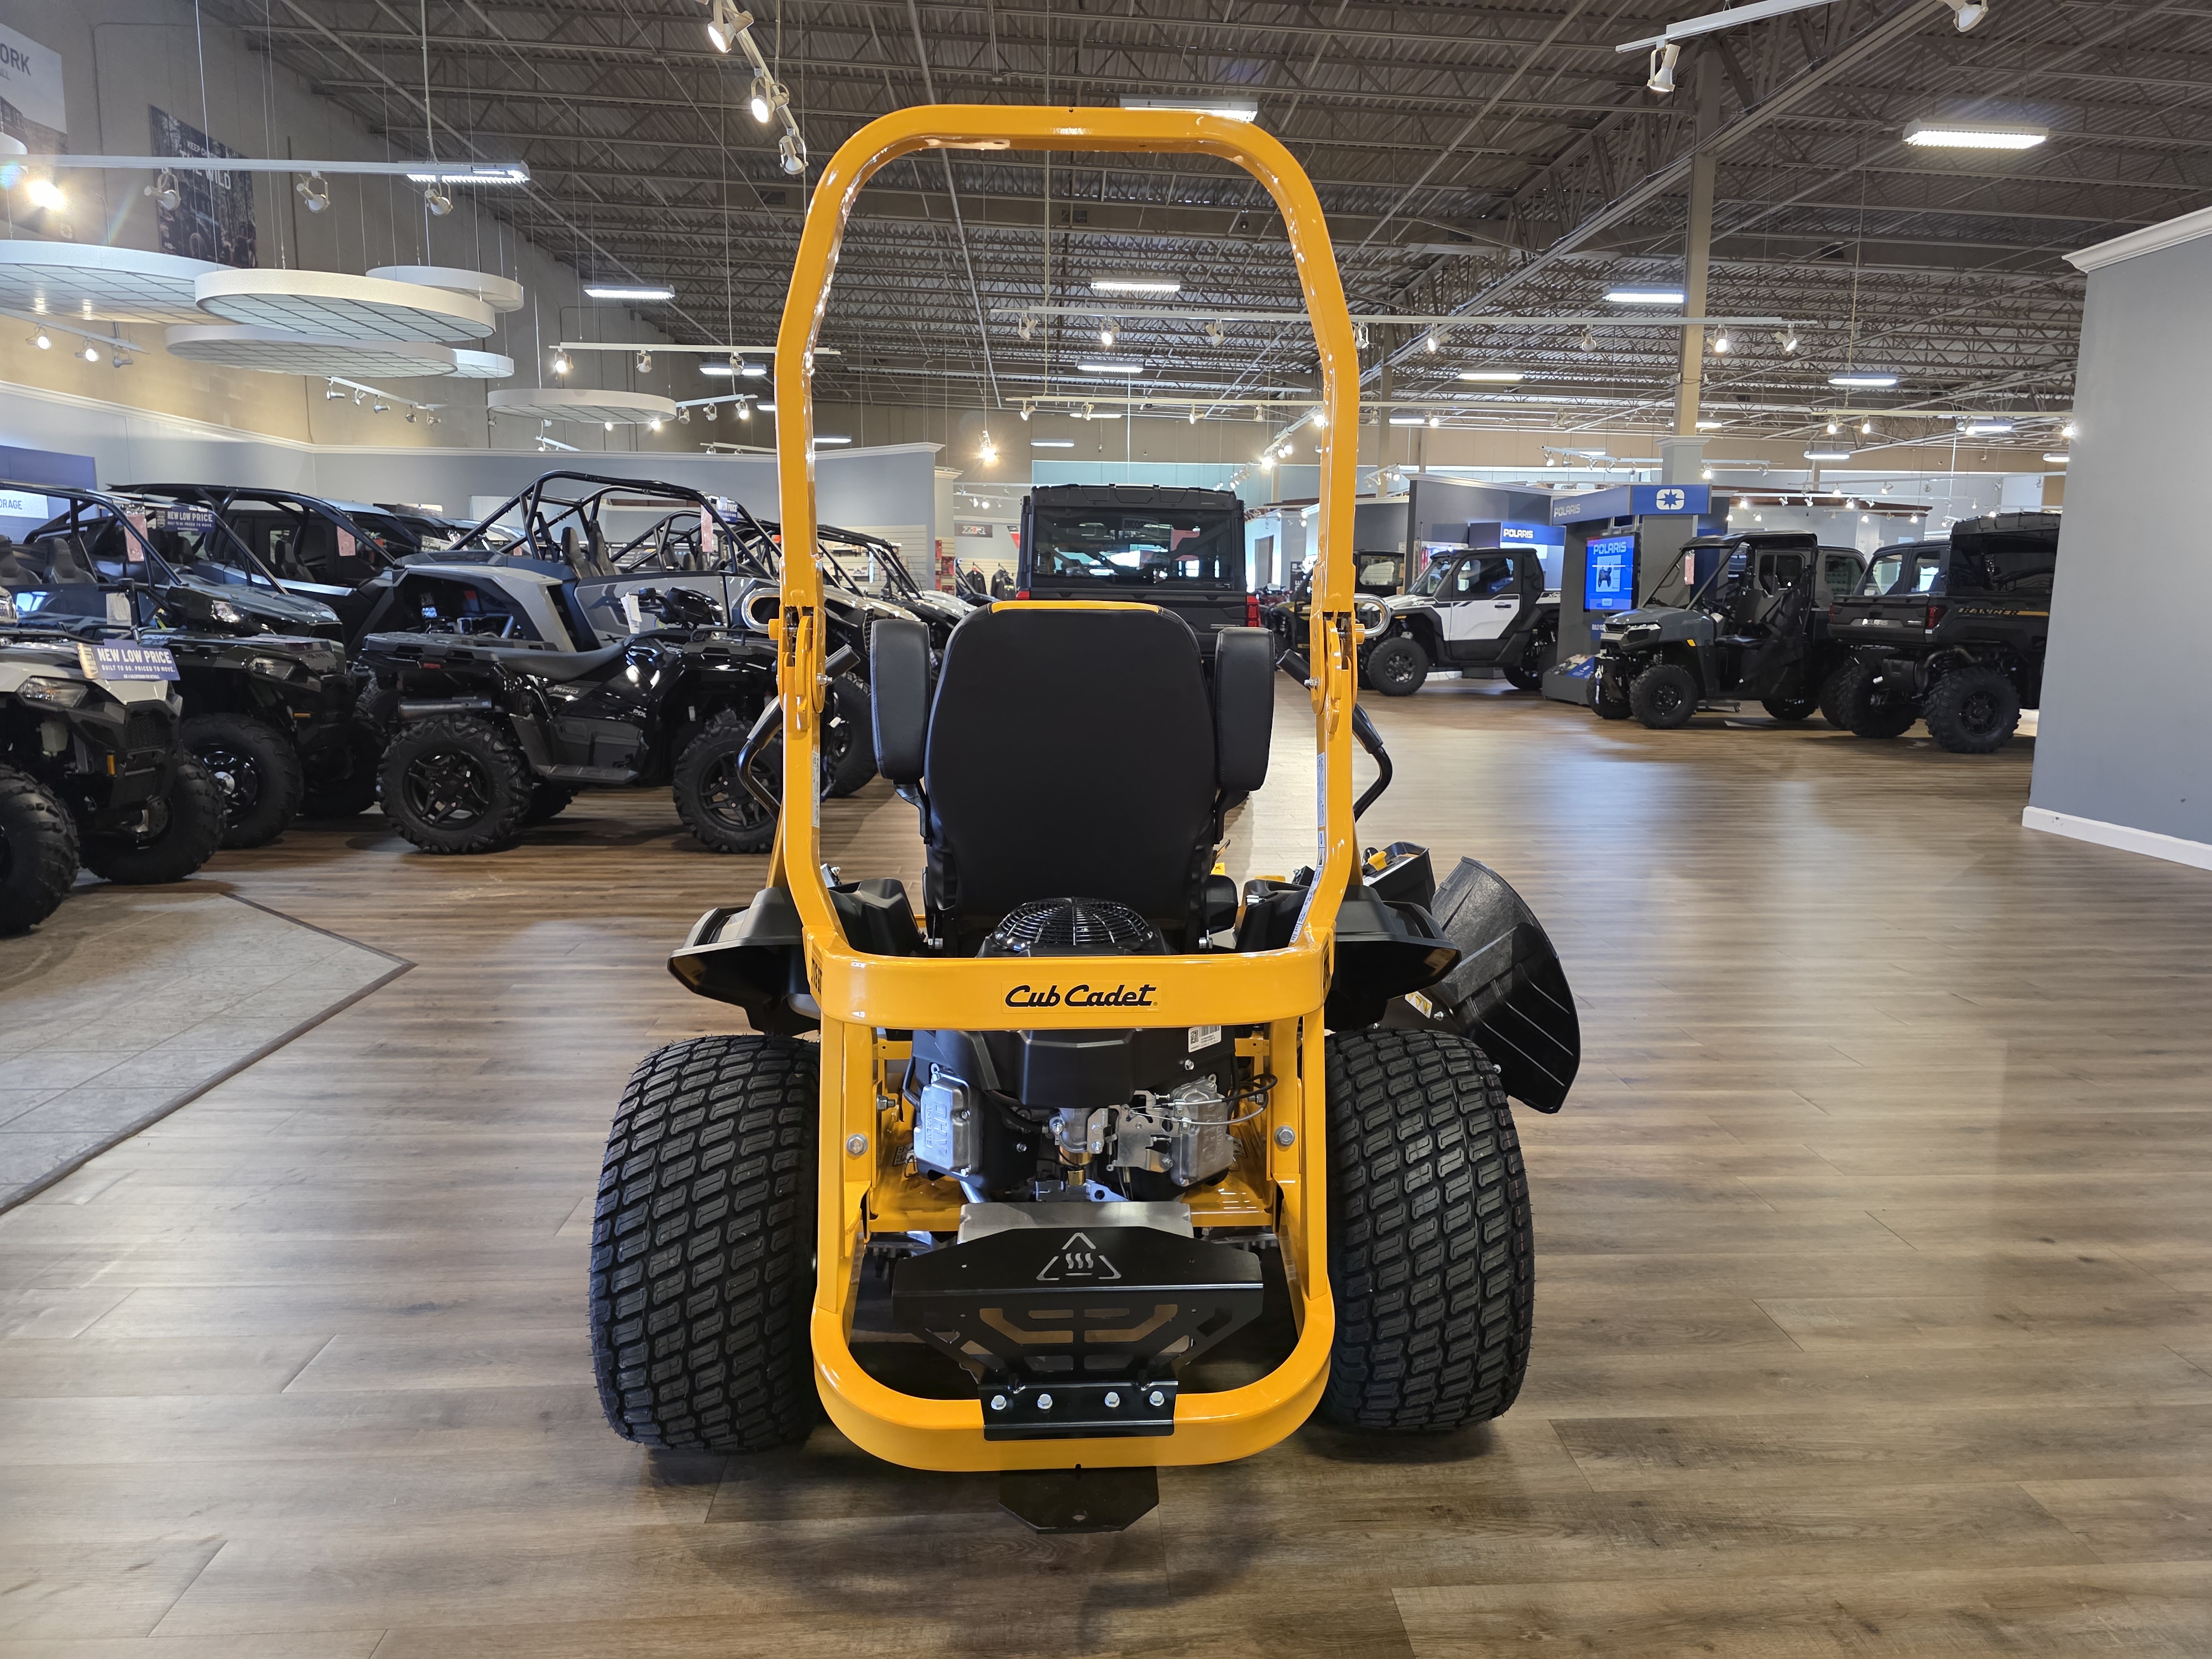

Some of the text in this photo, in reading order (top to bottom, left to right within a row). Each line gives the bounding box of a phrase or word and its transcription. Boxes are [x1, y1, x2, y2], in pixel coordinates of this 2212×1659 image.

[187, 140, 200, 153] KEEP
[167, 510, 179, 520] NEW
[180, 512, 191, 521] LOW
[192, 513, 213, 523] PRICE
[1553, 503, 1580, 517] POLARIS
[1503, 528, 1533, 539] POLARIS
[1593, 541, 1627, 555] POLARIS
[97, 648, 120, 662] NEW
[121, 649, 143, 663] LOW
[143, 650, 173, 664] PRICE
[1005, 983, 1157, 1008] Cub Cadet
